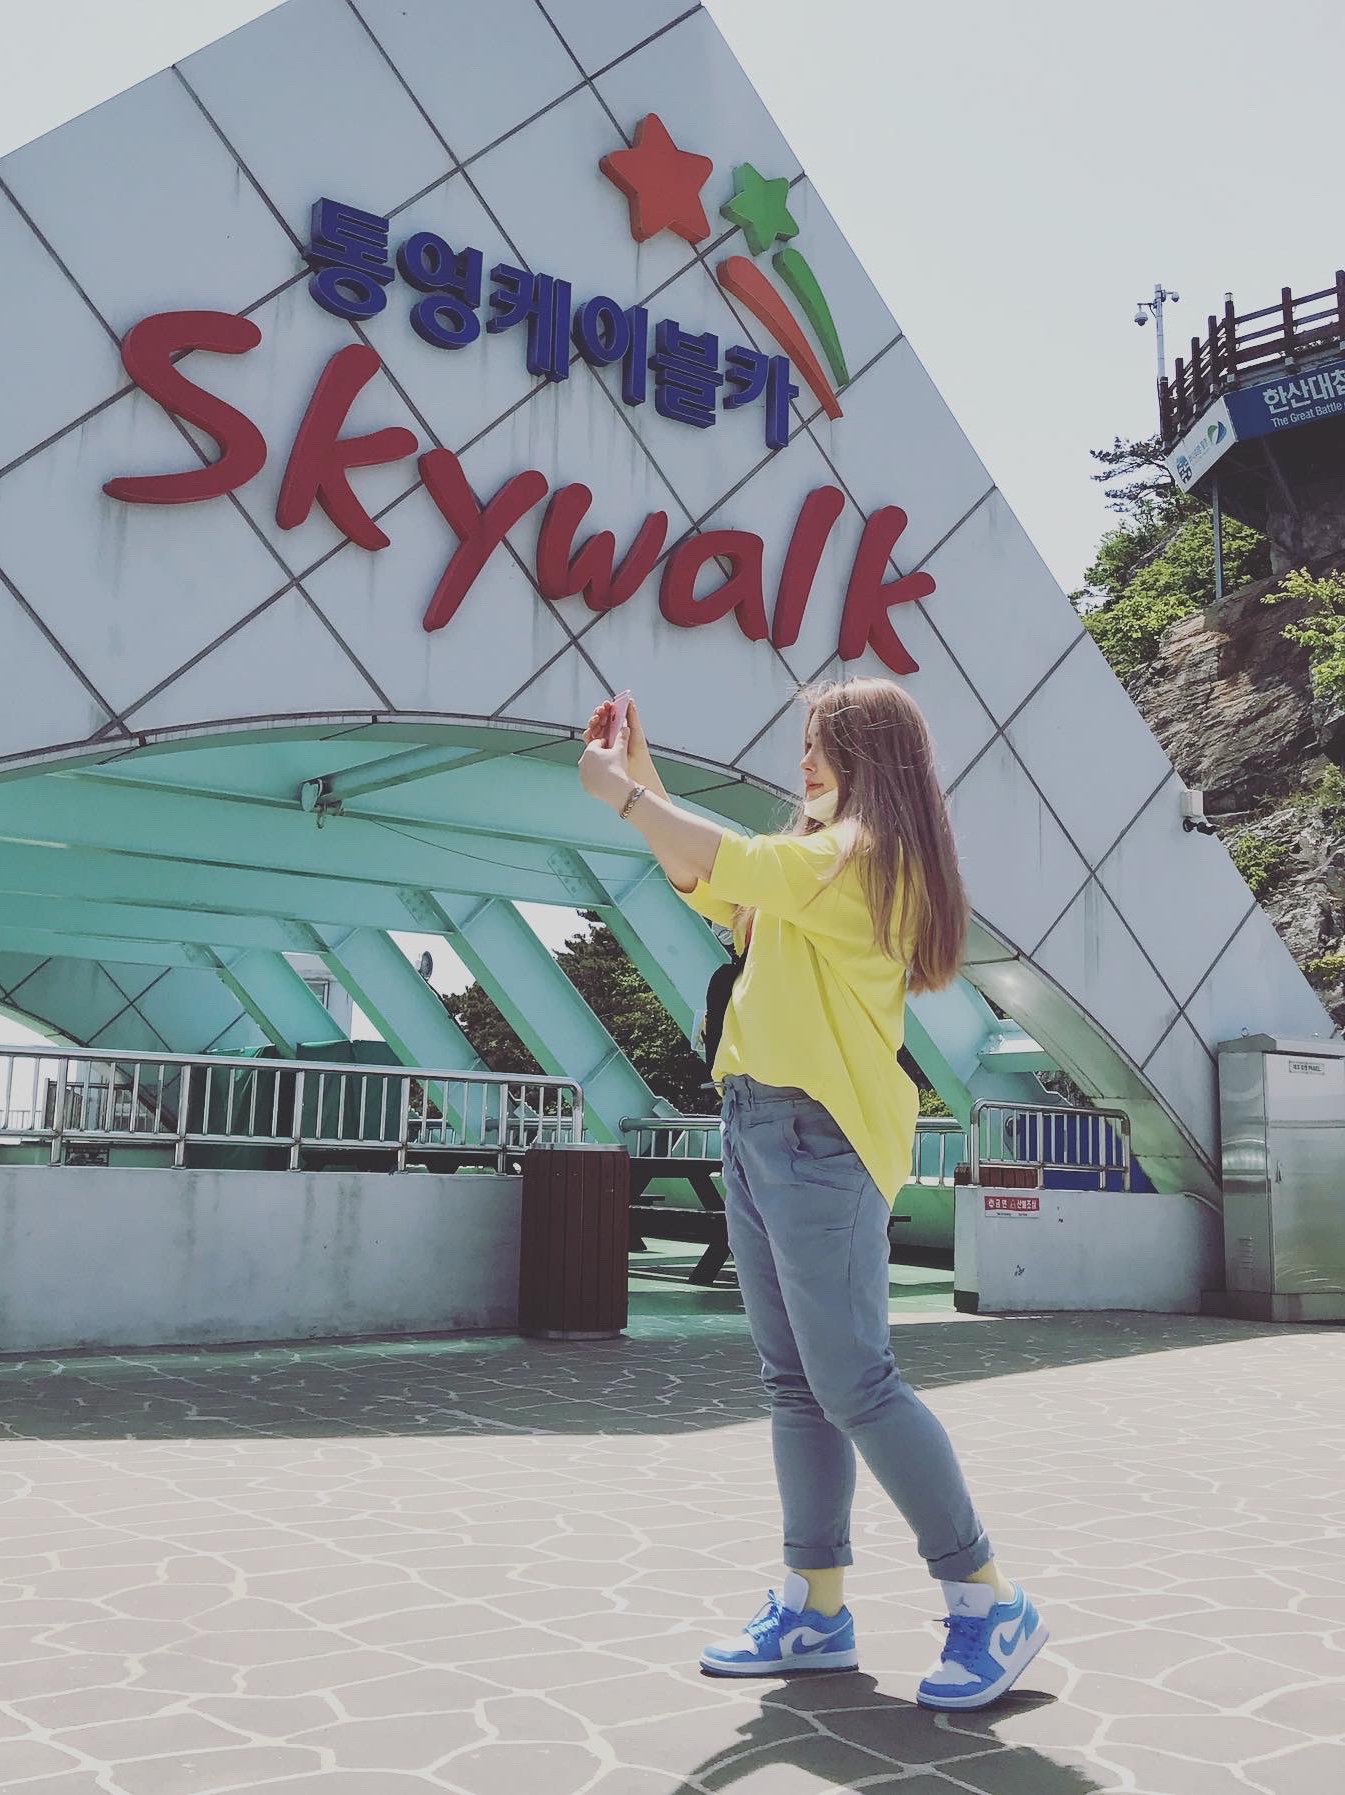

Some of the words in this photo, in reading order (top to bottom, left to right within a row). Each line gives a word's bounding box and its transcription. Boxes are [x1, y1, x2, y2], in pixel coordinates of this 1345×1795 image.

[309, 197, 799, 450] 통영케이블카
[1270, 416, 1289, 428] The
[1289, 408, 1316, 423] Great
[1315, 401, 1343, 416] Battle
[102, 309, 937, 675] Skywalk
